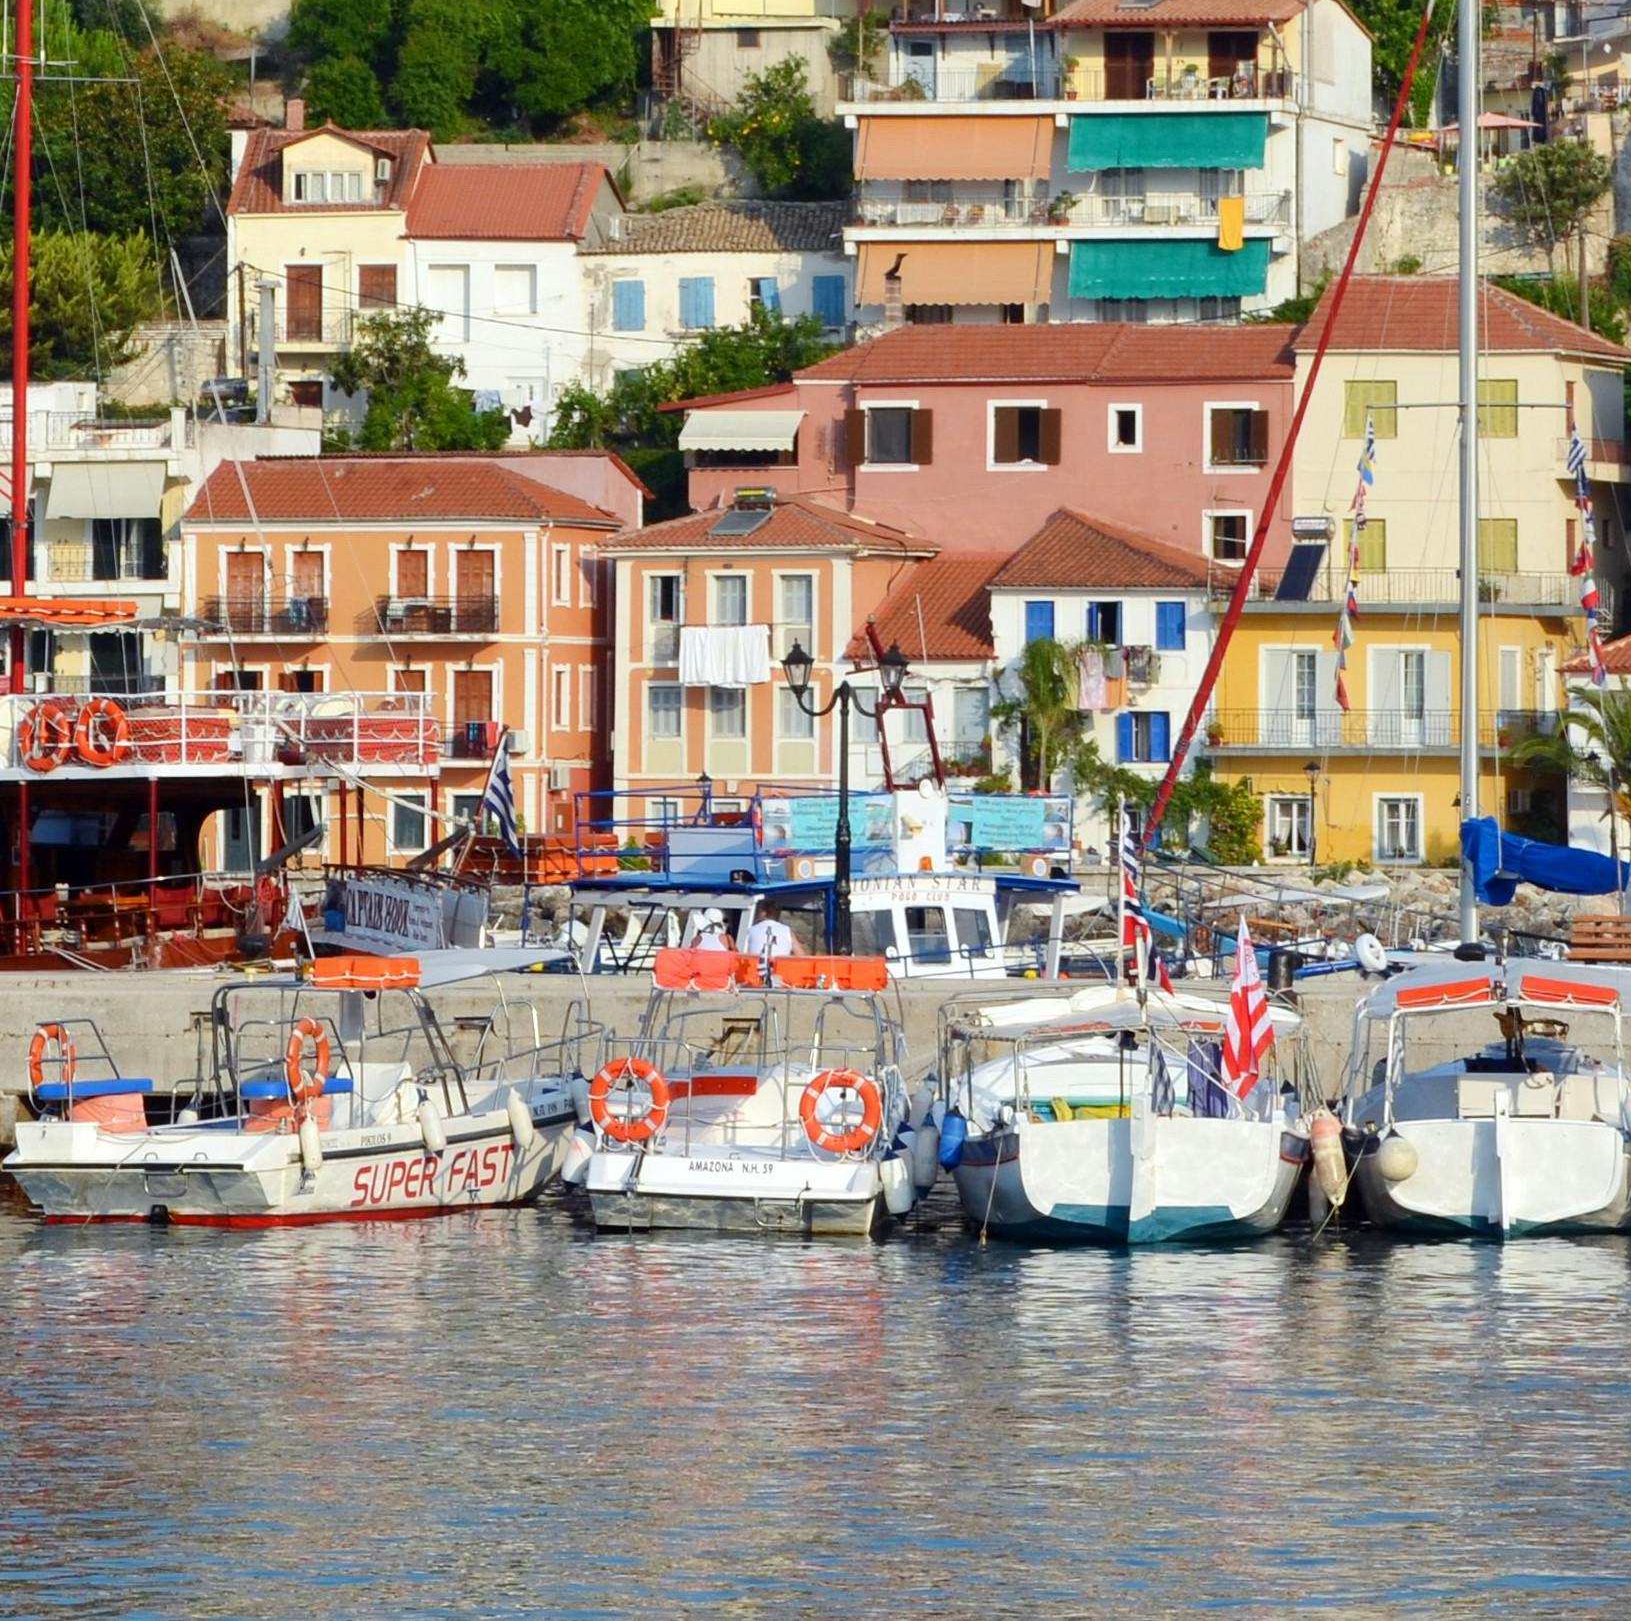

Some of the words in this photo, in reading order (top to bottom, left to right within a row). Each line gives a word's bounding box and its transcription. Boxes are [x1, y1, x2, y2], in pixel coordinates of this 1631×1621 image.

[852, 874, 917, 892] IONIAN
[931, 874, 981, 891] STAR
[346, 889, 384, 930] CAPTAIN
[384, 895, 410, 938] HOOK
[351, 1154, 438, 1207] SUPER
[447, 1144, 515, 1192] FAST
[688, 1160, 734, 1172] AMAZONA
